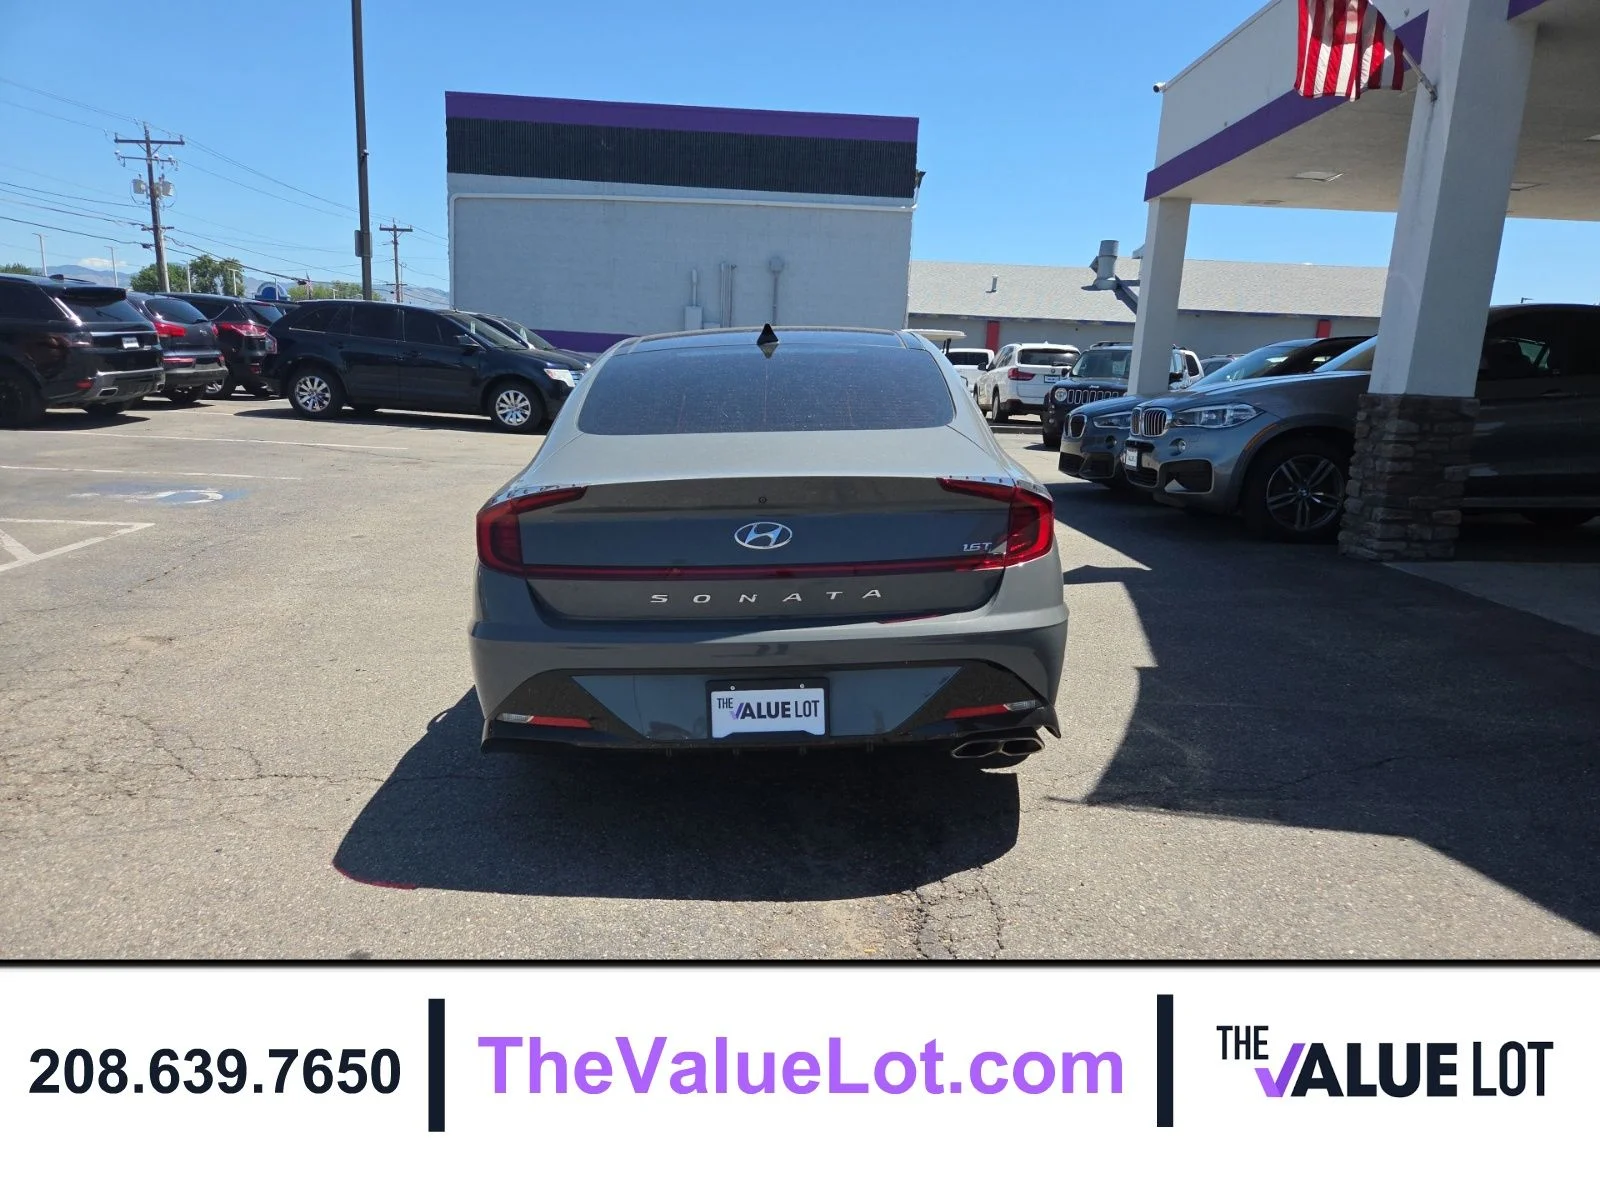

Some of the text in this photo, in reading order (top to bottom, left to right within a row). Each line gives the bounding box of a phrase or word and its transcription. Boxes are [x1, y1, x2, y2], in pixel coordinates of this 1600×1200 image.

[650, 589, 882, 604] SONATA
[716, 697, 820, 720] THE VALUE LOT
